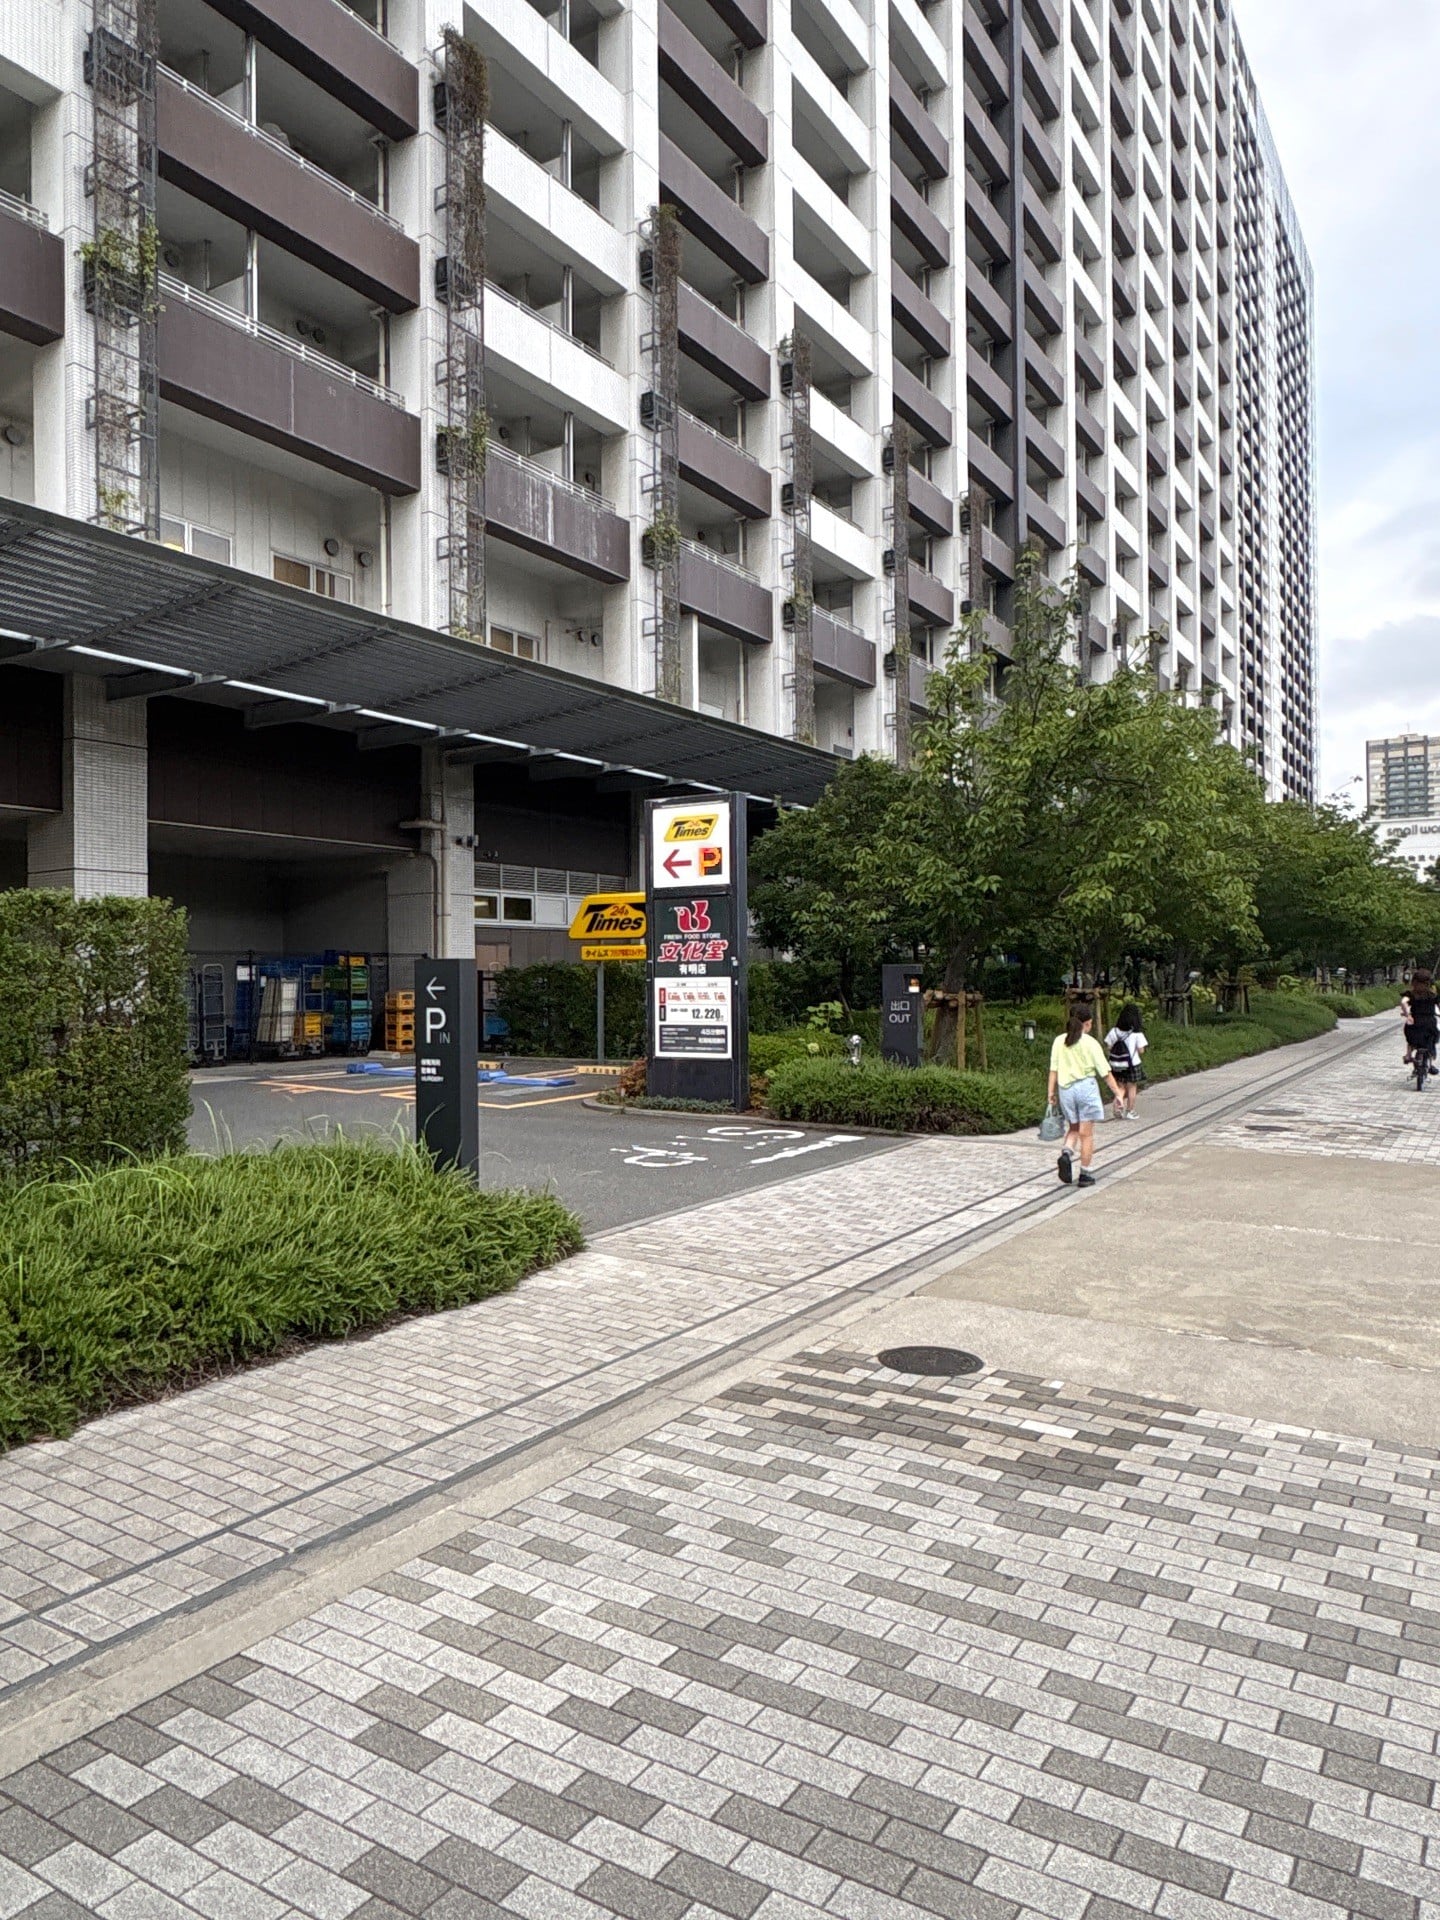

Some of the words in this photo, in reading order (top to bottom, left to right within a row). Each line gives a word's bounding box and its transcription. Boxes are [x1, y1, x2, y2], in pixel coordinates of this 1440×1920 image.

[673, 821, 711, 839] Times
[1387, 824, 1418, 837] small
[1420, 825, 1440, 835] wo
[699, 847, 722, 878] P
[584, 909, 644, 933] Times
[657, 939, 728, 962] 文化堂
[679, 963, 707, 975] 有明店
[891, 1001, 909, 1011] 出口
[426, 1007, 446, 1044] P
[889, 1014, 912, 1023] OUT
[439, 1032, 451, 1044] IN
